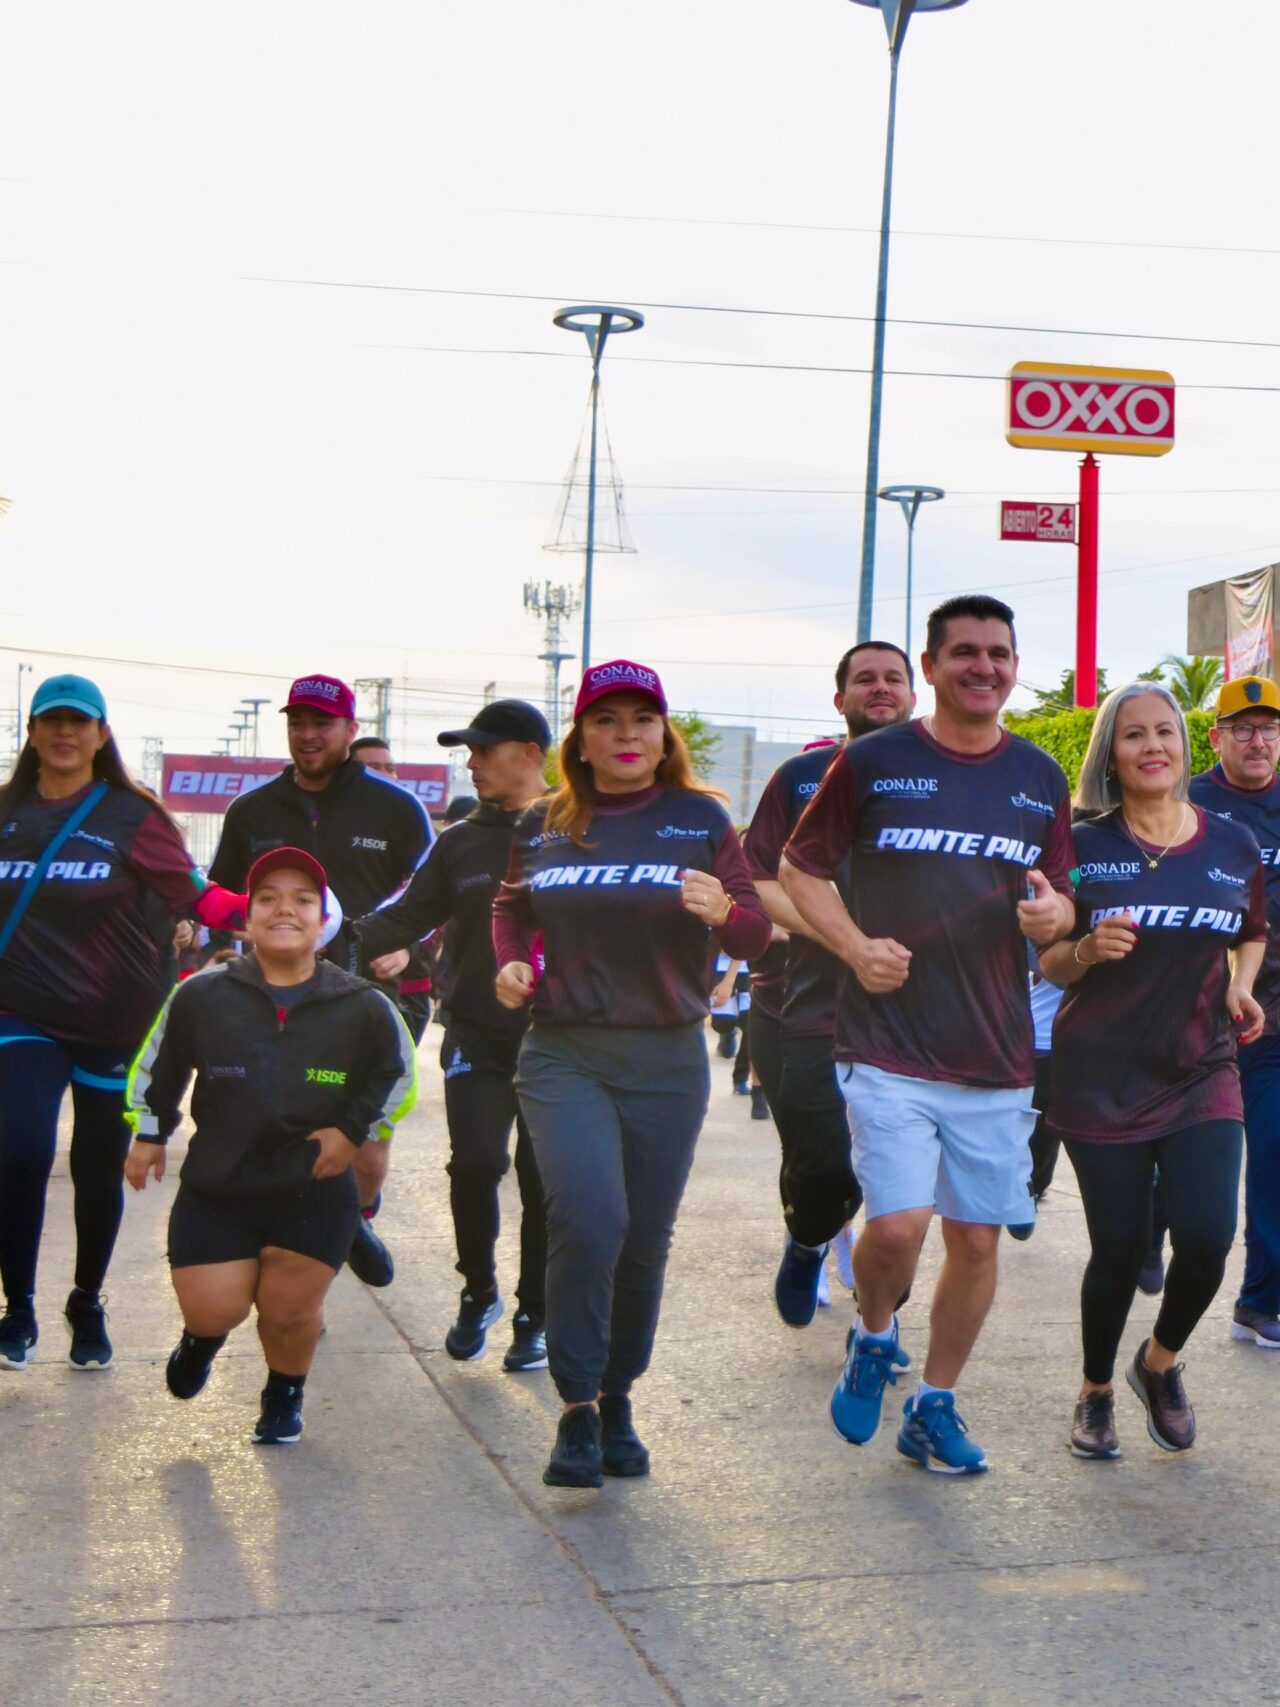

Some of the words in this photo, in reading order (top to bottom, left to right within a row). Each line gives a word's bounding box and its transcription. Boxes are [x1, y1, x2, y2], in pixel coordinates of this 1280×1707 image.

[1015, 381, 1170, 435] OXXO
[1038, 506, 1072, 529] 24
[590, 664, 656, 684] CONADE
[293, 680, 341, 696] CONADE
[873, 777, 938, 792] CONADE
[361, 838, 387, 850] ISDE
[877, 827, 984, 855] PONTE
[984, 836, 1042, 867] PILA
[47, 862, 112, 880] PILA
[630, 864, 686, 887] PIL
[1079, 862, 1140, 877] CONADE
[316, 1069, 347, 1084] ISDE
